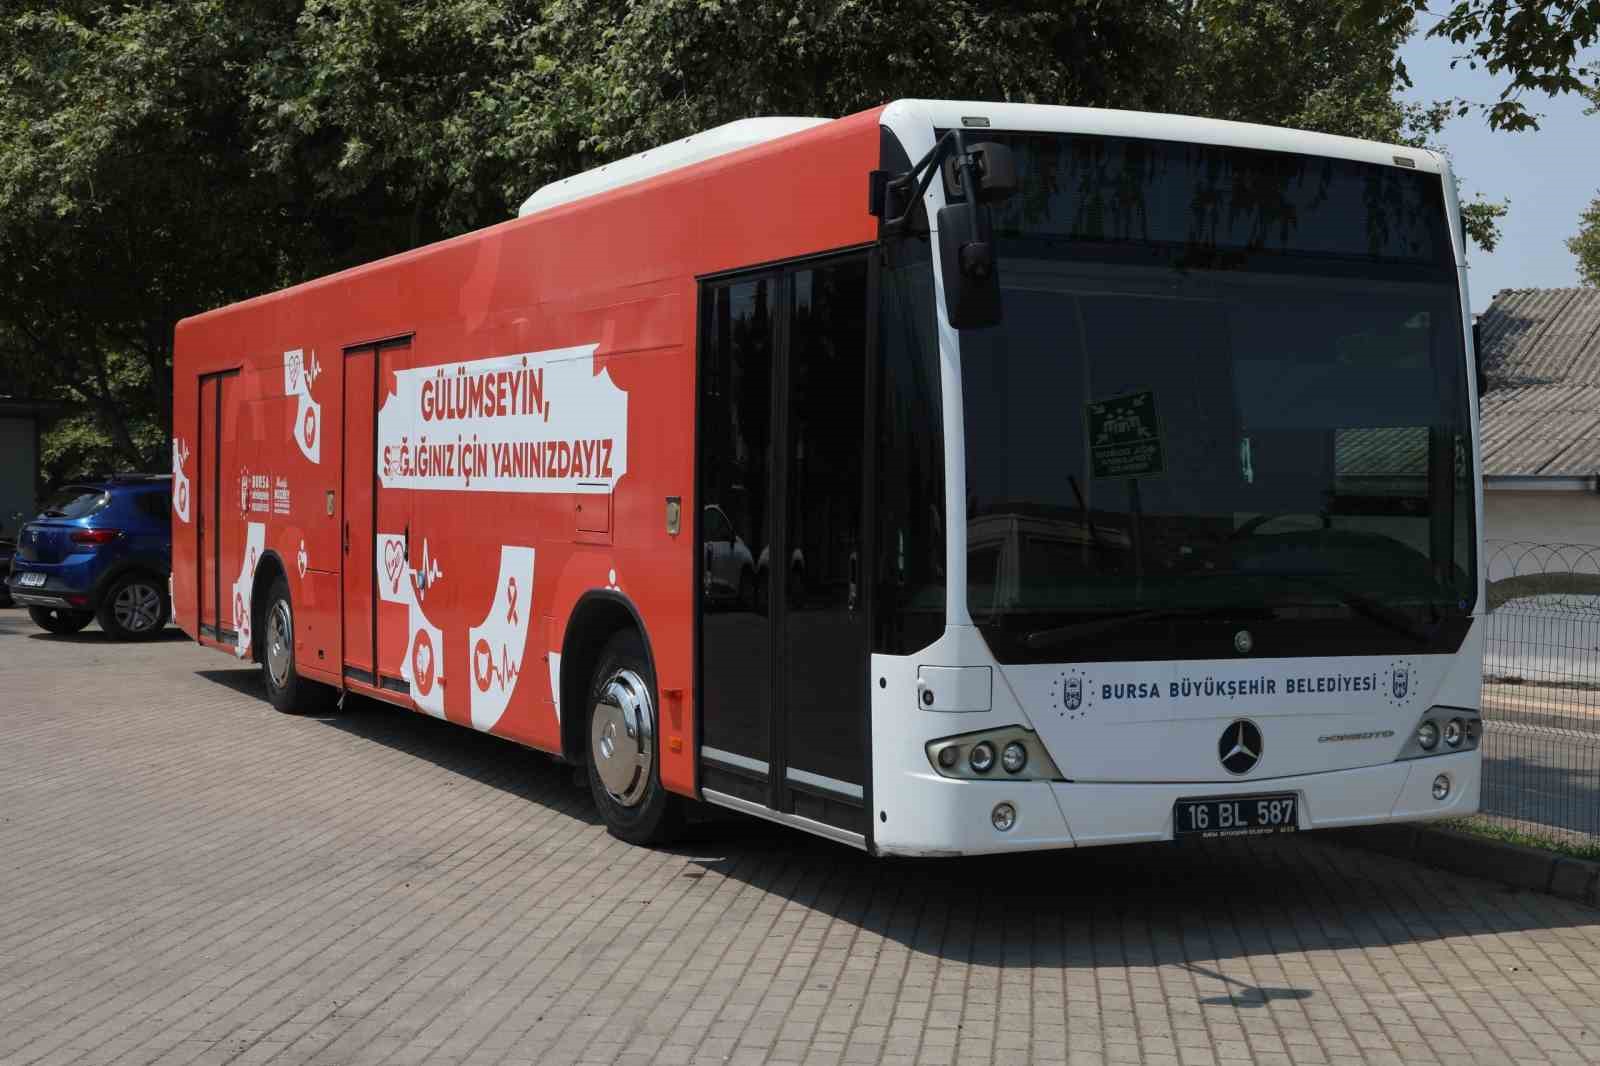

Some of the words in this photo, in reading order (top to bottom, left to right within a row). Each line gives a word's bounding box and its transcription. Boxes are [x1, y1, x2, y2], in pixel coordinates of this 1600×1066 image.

[421, 356, 549, 422] GÜLÜMSEYİN,
[458, 433, 487, 487] İÇİN
[492, 438, 613, 478] YANINIZDAYIZ
[1102, 683, 1160, 700] BURSA
[1169, 676, 1276, 700] BÜYÜKŞEHİR
[1286, 673, 1376, 694] BELEDİYESİ
[1188, 804, 1209, 829] 16
[1218, 802, 1248, 828] BL
[1257, 799, 1294, 825] 587
